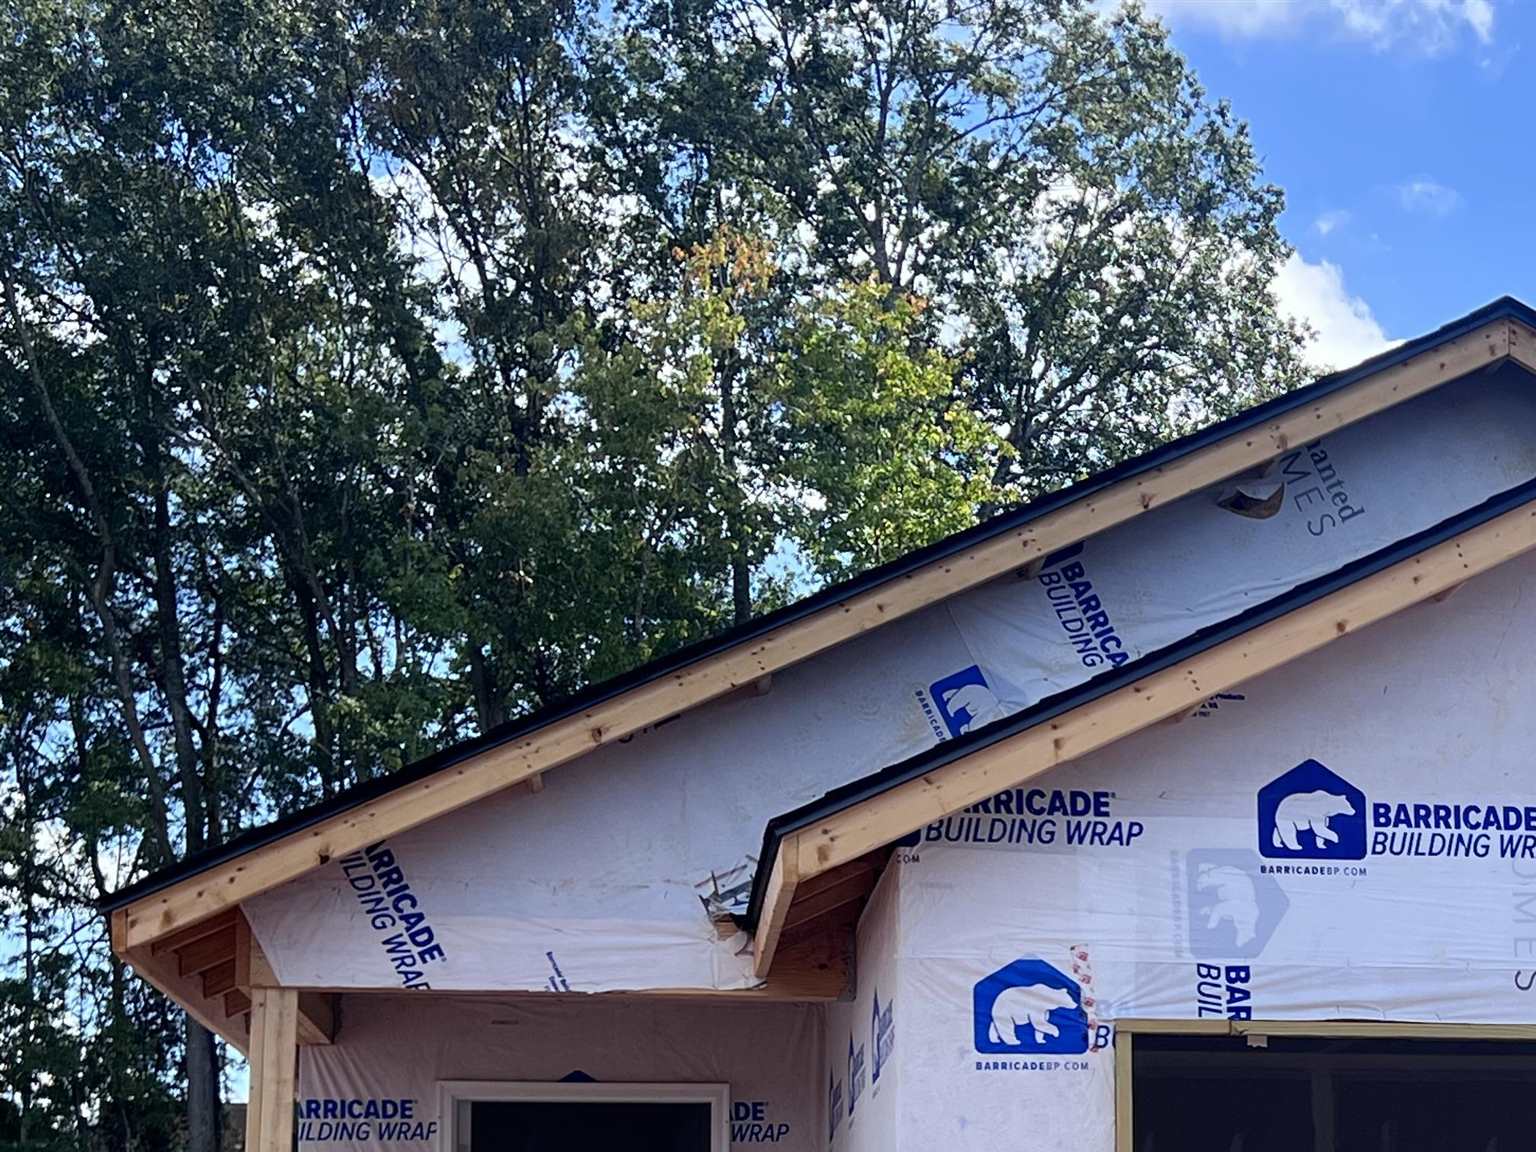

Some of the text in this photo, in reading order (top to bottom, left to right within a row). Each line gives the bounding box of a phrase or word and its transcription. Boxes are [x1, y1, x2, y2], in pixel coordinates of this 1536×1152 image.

[1281, 451, 1336, 536] MES
[1308, 440, 1365, 523] anted
[1039, 572, 1104, 669] BUILDING
[1060, 561, 1131, 668] BARRICA
[963, 789, 1110, 817] RRICADE
[925, 817, 1144, 847] BUILDING WRAP
[1371, 832, 1490, 858] BUILDING
[1260, 864, 1368, 877] BARRICADEBP.COM
[340, 852, 396, 930] ILDING
[976, 1061, 1089, 1071] BARRICADEBP.COM
[732, 1123, 790, 1142] WRAP
